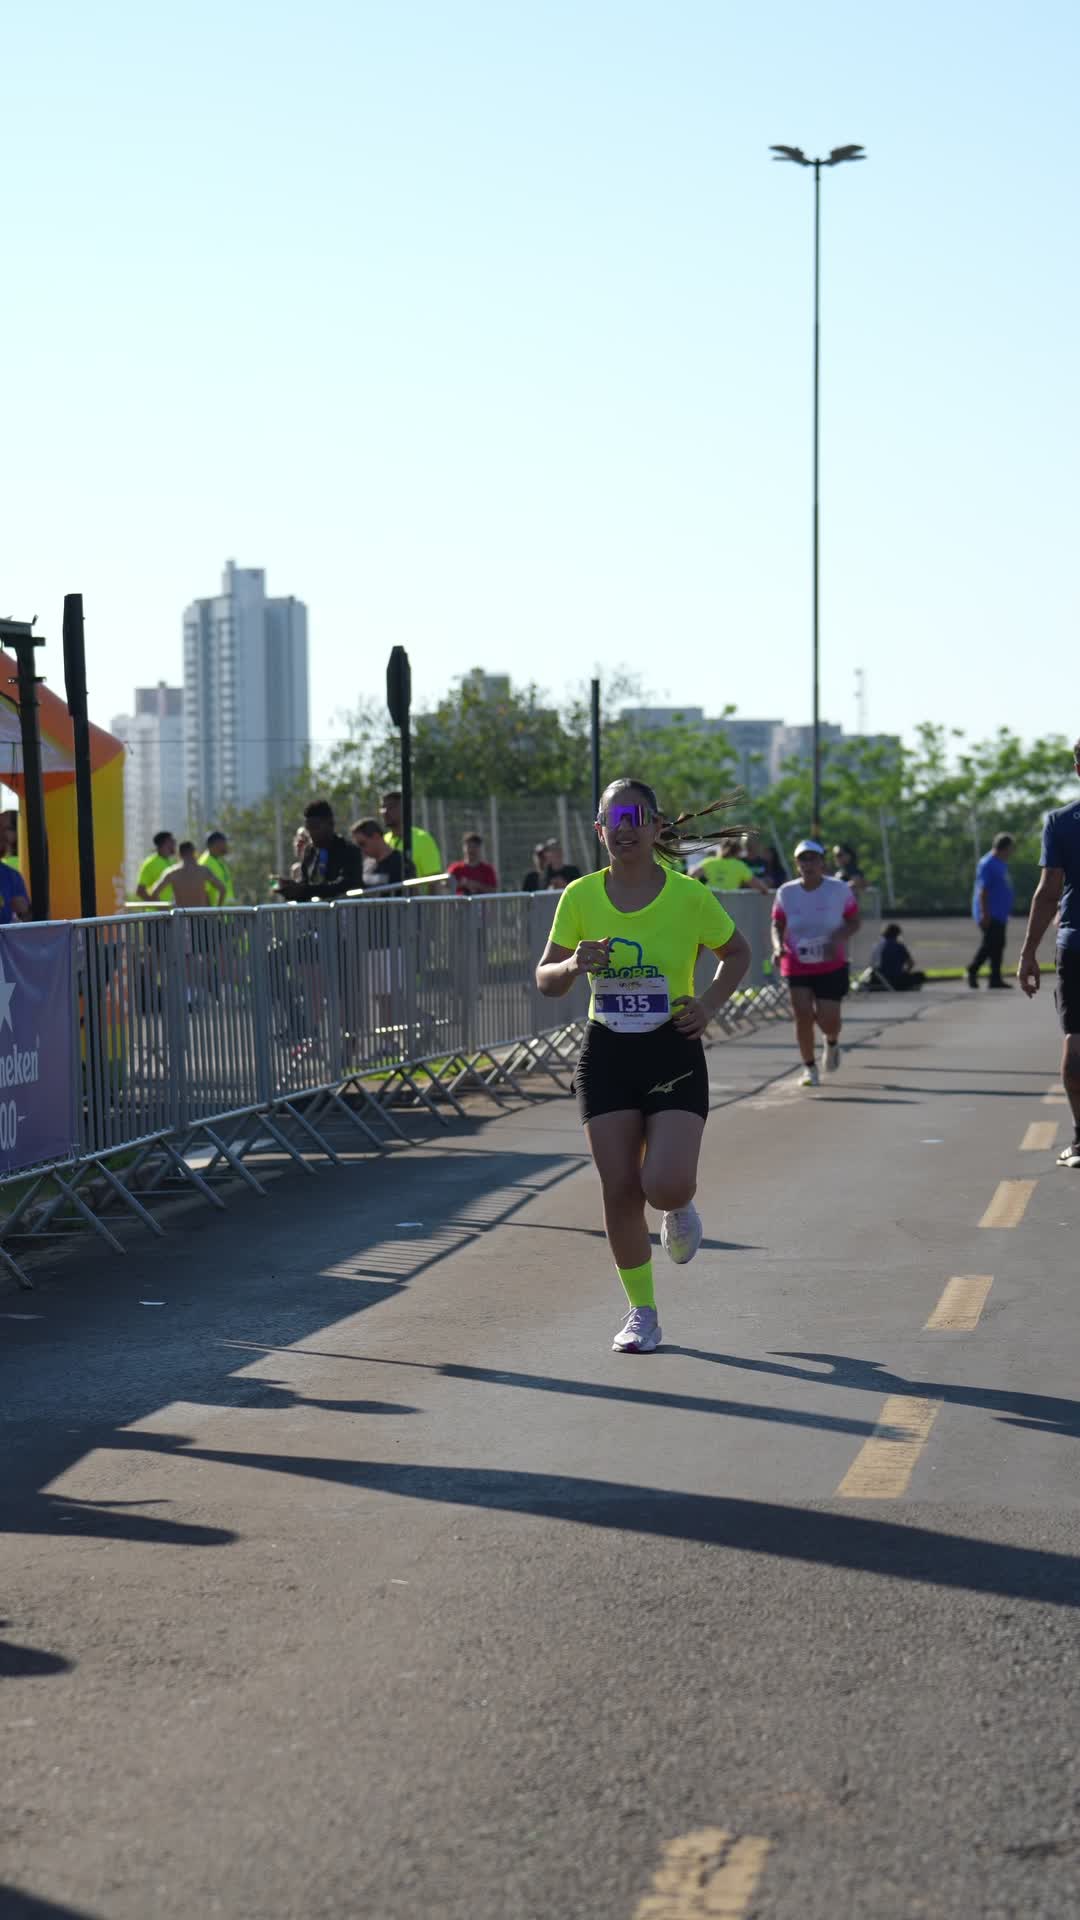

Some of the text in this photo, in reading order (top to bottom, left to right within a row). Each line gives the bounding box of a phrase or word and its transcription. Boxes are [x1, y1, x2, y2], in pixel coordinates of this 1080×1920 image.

[597, 965, 664, 979] ELOBEL
[615, 995, 651, 1012] 135
[0, 1043, 39, 1088] neken
